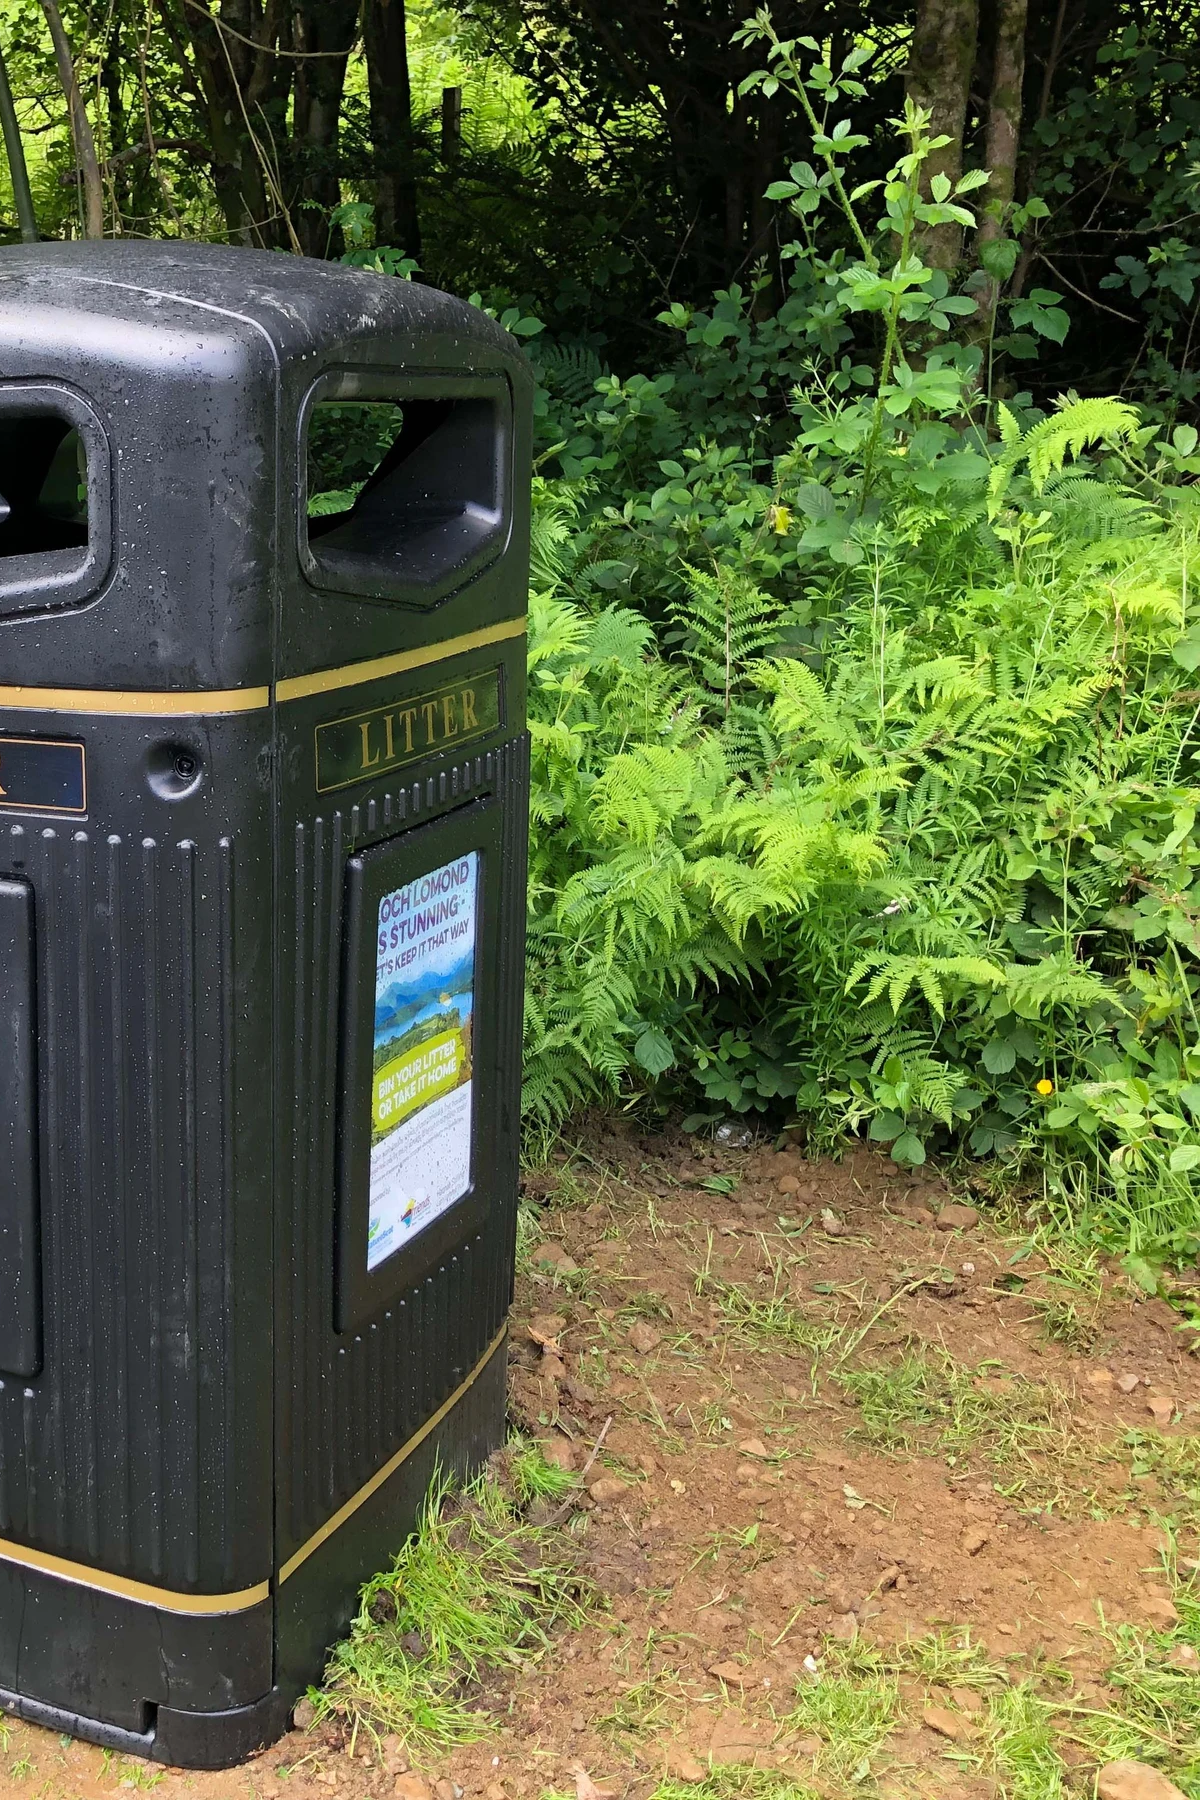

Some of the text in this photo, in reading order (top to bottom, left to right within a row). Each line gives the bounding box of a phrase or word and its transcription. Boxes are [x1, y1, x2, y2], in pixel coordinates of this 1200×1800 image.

[358, 688, 480, 769] LITTER
[378, 861, 470, 924] OCH LOMOND
[390, 894, 459, 949] STUNNING
[395, 946, 417, 971] KEEP
[418, 941, 427, 958] IT
[427, 928, 449, 954] THAT
[450, 918, 470, 940] WAY
[378, 1038, 456, 1100] BIN YOUR LITTER
[379, 1057, 457, 1120] OR TAKE IT HOME
